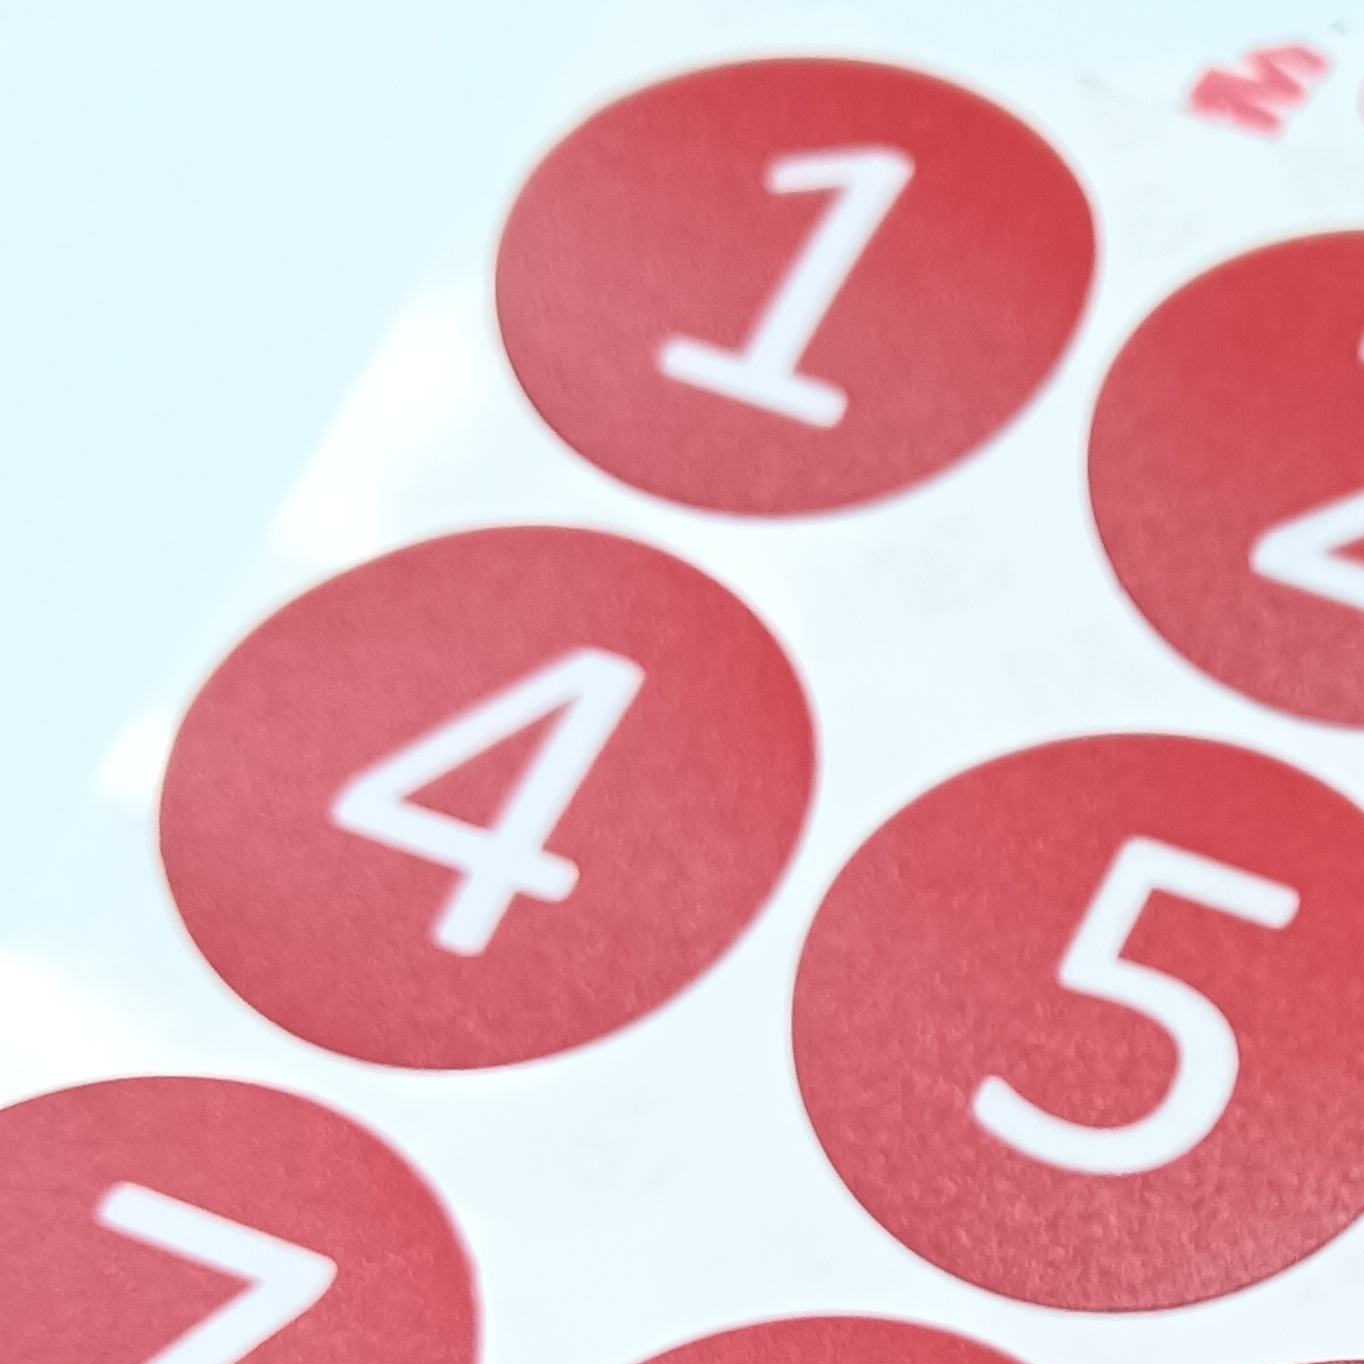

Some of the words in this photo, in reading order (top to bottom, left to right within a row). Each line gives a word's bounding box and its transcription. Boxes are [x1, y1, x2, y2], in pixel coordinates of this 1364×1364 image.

[1190, 45, 1327, 136] M
[660, 149, 914, 429] 1
[331, 647, 645, 956] 4
[972, 838, 1299, 1177] 5
